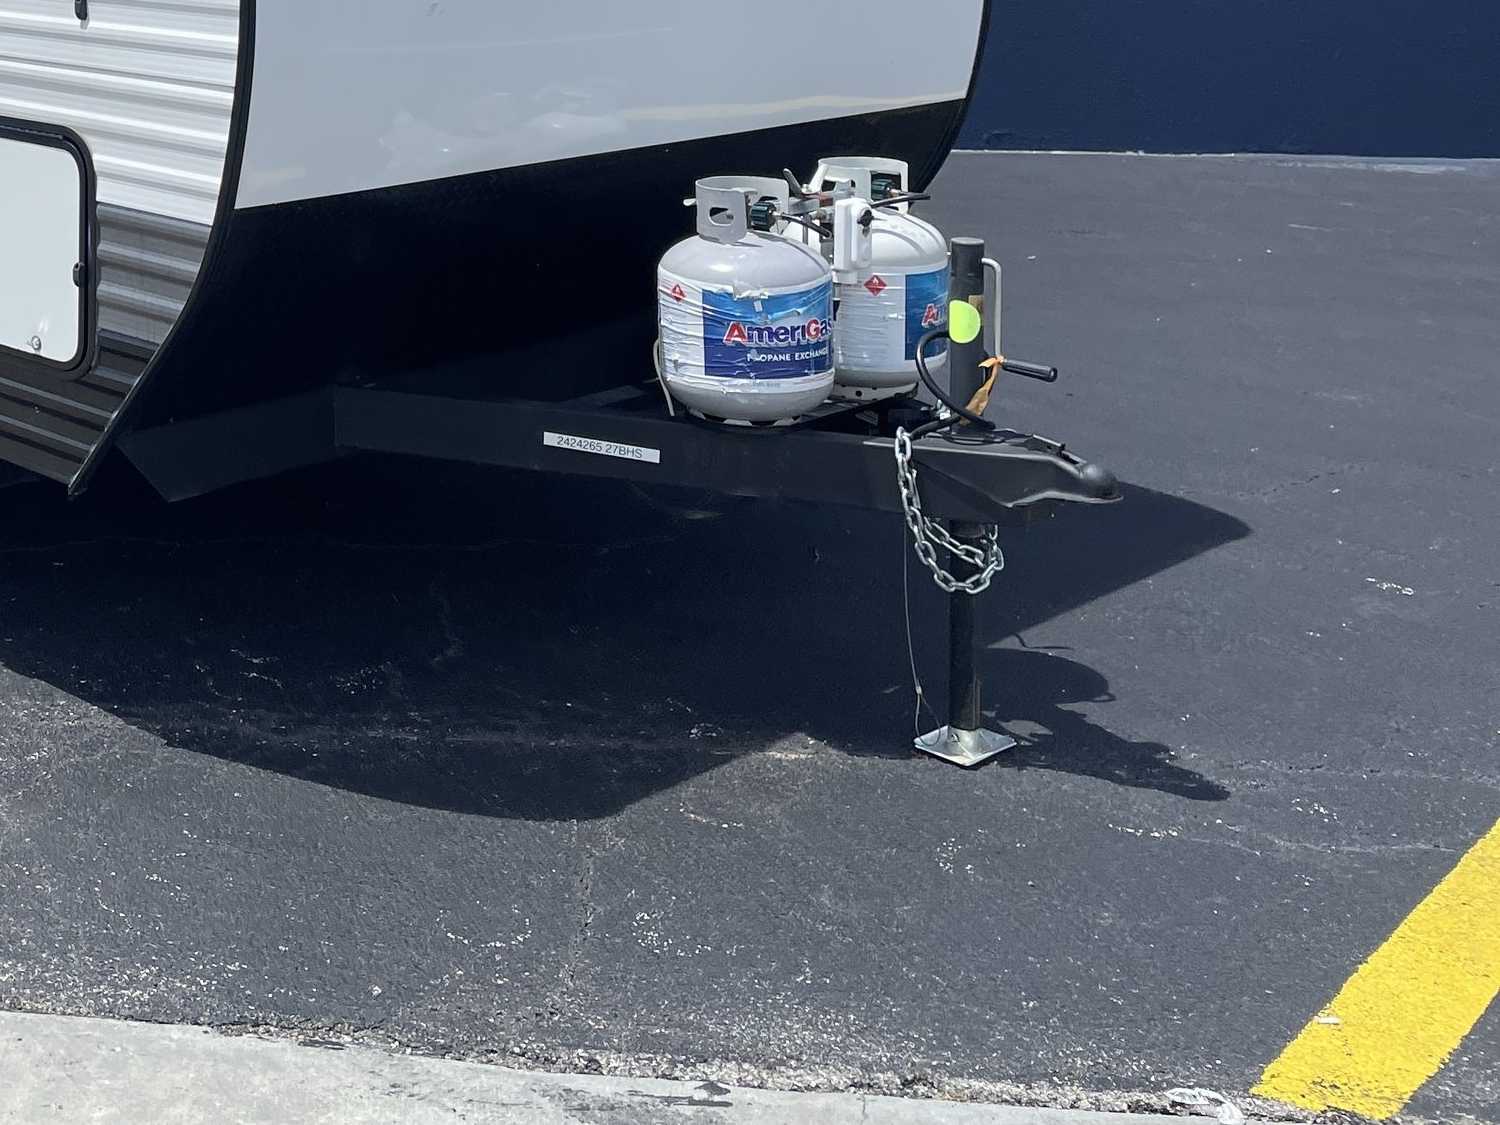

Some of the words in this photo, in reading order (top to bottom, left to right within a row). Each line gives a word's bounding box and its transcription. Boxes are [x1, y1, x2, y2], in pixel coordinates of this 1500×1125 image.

[746, 353, 791, 362] POPANE
[556, 436, 602, 452] 2424265
[605, 444, 643, 459] 27BHS
